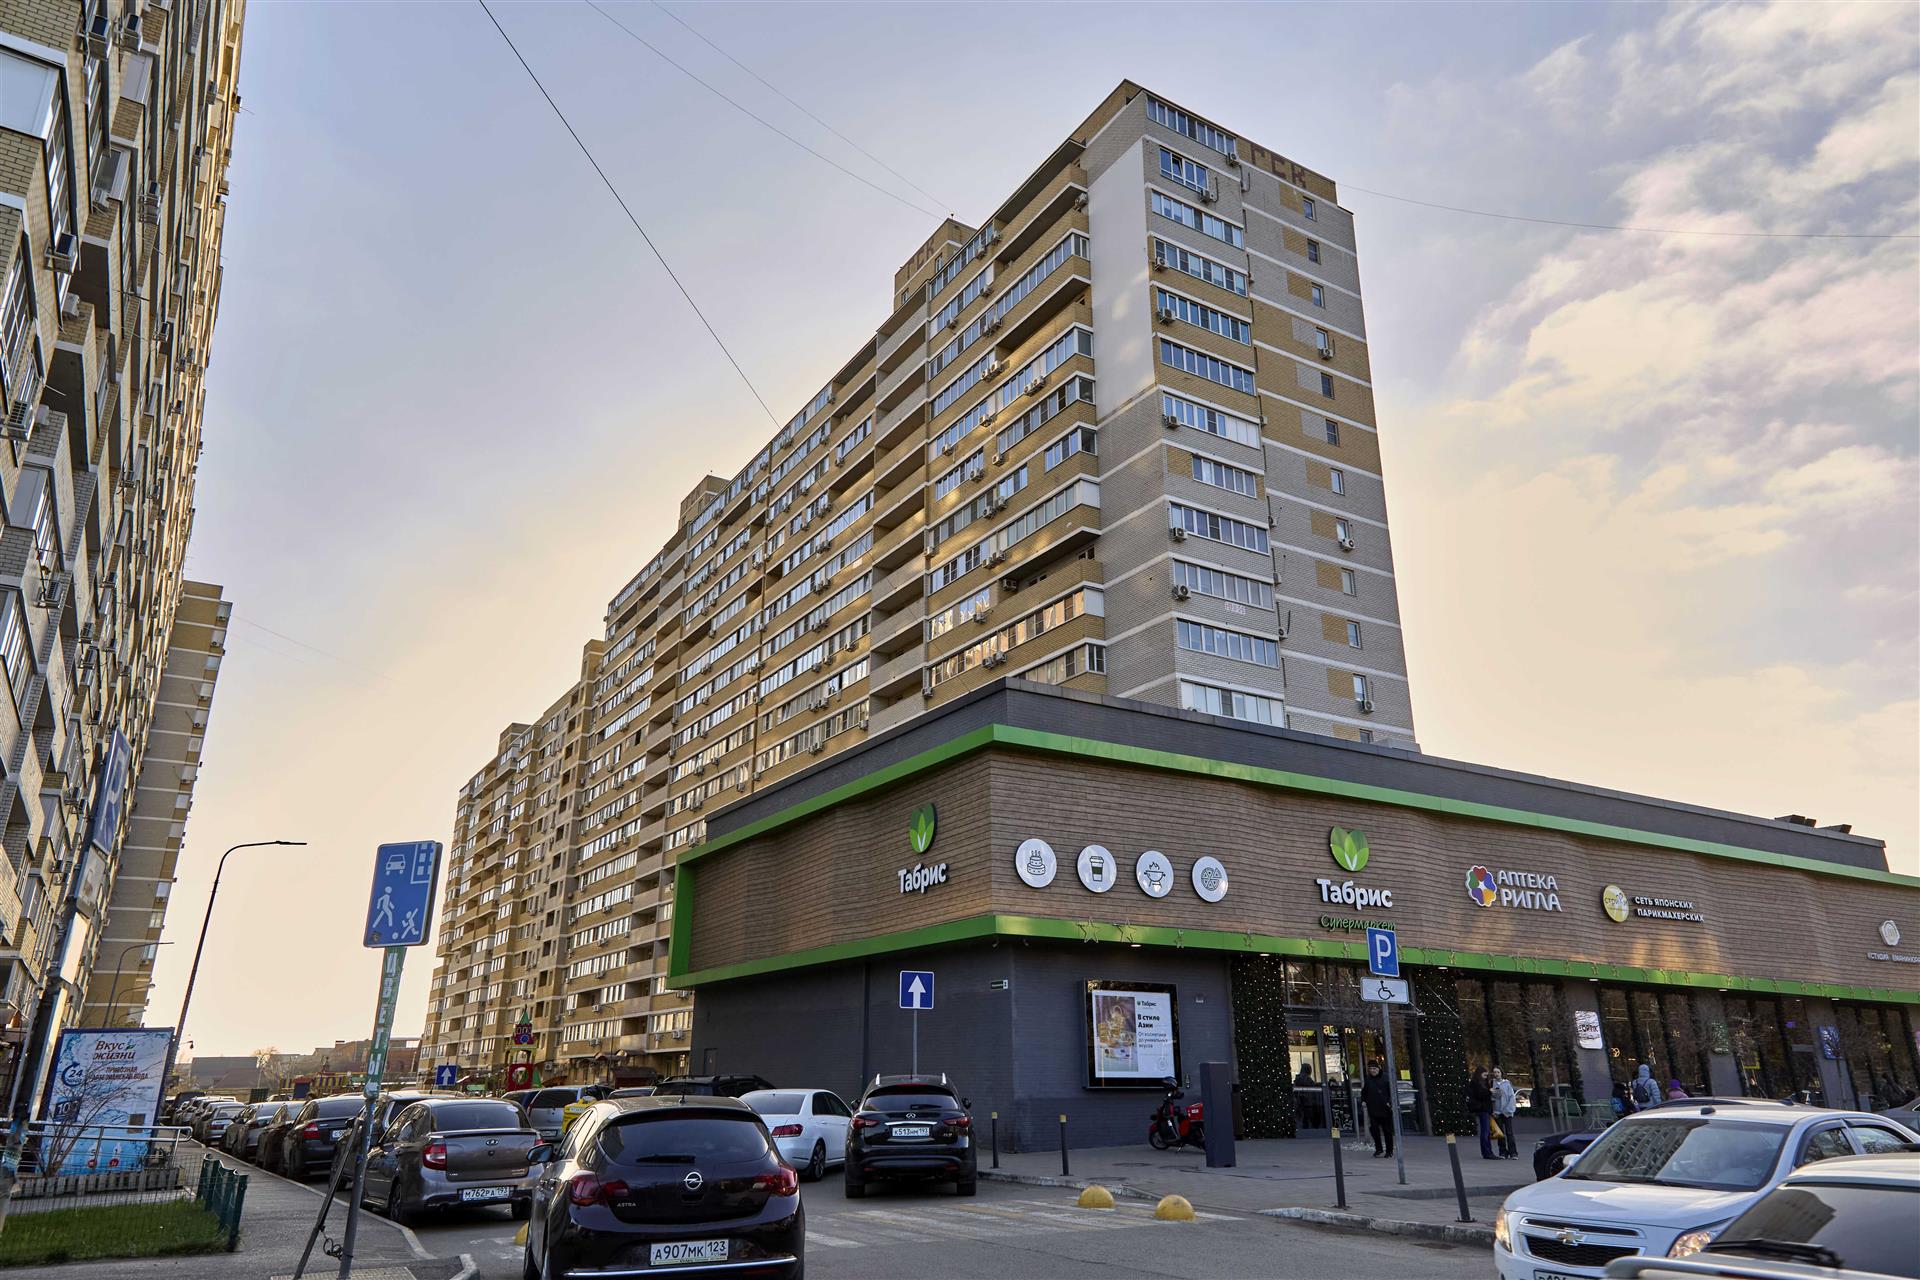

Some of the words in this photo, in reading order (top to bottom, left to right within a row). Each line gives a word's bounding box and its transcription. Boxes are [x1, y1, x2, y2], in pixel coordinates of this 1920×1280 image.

[1250, 144, 1307, 188] ГСК
[898, 863, 947, 894] Табрис
[1498, 870, 1559, 891] АПТЕКА
[1317, 879, 1393, 910] Табрис
[1501, 888, 1563, 912] РИГЛА
[1635, 896, 1653, 906] СЕТЬ
[1655, 898, 1694, 909] ЯПОНСКИХ
[1637, 908, 1705, 922] ПАРИКМАХЕРСКИХ
[1375, 934, 1392, 968] P
[367, 952, 398, 1075] ЦВЕТЫ
[95, 1040, 124, 1052] Вкус
[92, 1052, 136, 1061] жизни
[68, 1069, 84, 1078] 24
[465, 1189, 495, 1198] М762РА
[655, 1244, 704, 1260] А907МК
[708, 1240, 727, 1252] 123
